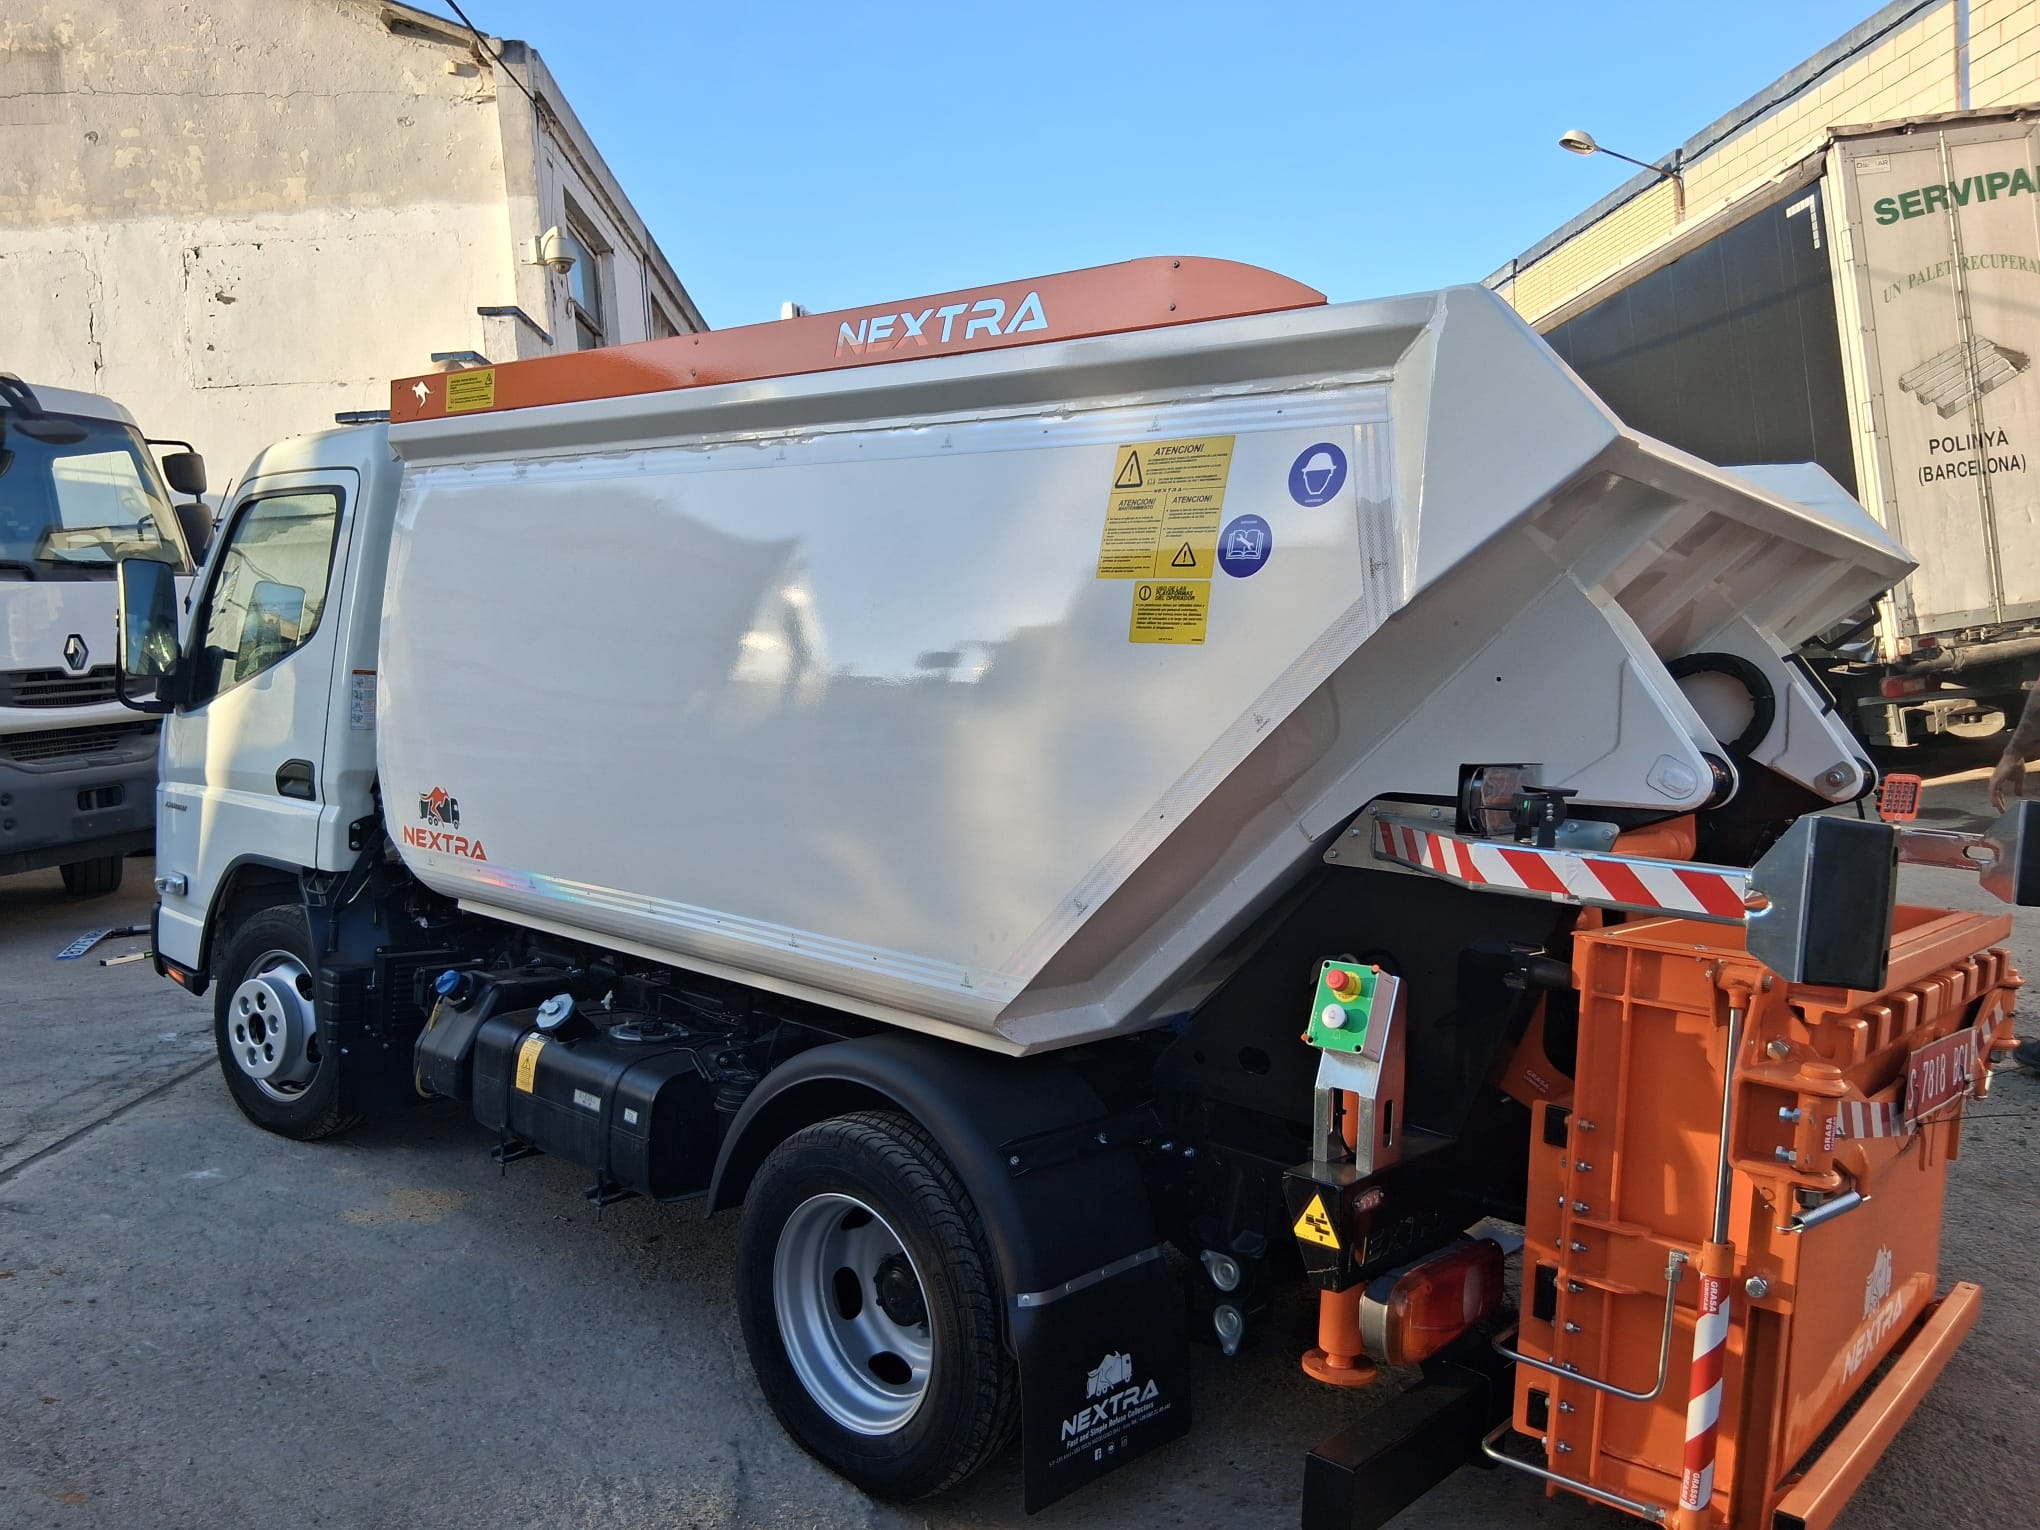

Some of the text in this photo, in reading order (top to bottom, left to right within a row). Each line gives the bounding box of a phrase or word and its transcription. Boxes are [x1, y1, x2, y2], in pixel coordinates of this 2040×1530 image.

[1874, 165, 2040, 226] SERVIPA
[1883, 279, 1904, 304] UN
[1908, 259, 1955, 289] PALET
[834, 290, 1049, 359] NEXTRA
[1929, 426, 2009, 455] POLINYÀ
[403, 825, 488, 861] NEXTRA
[1922, 1053, 1946, 1103] 7818
[1709, 1280, 1719, 1312] GRASA
[1842, 1289, 1902, 1385] NEXTRA
[1061, 1378, 1159, 1441] NEXTRA
[1689, 1472, 1700, 1505] GRASSO
